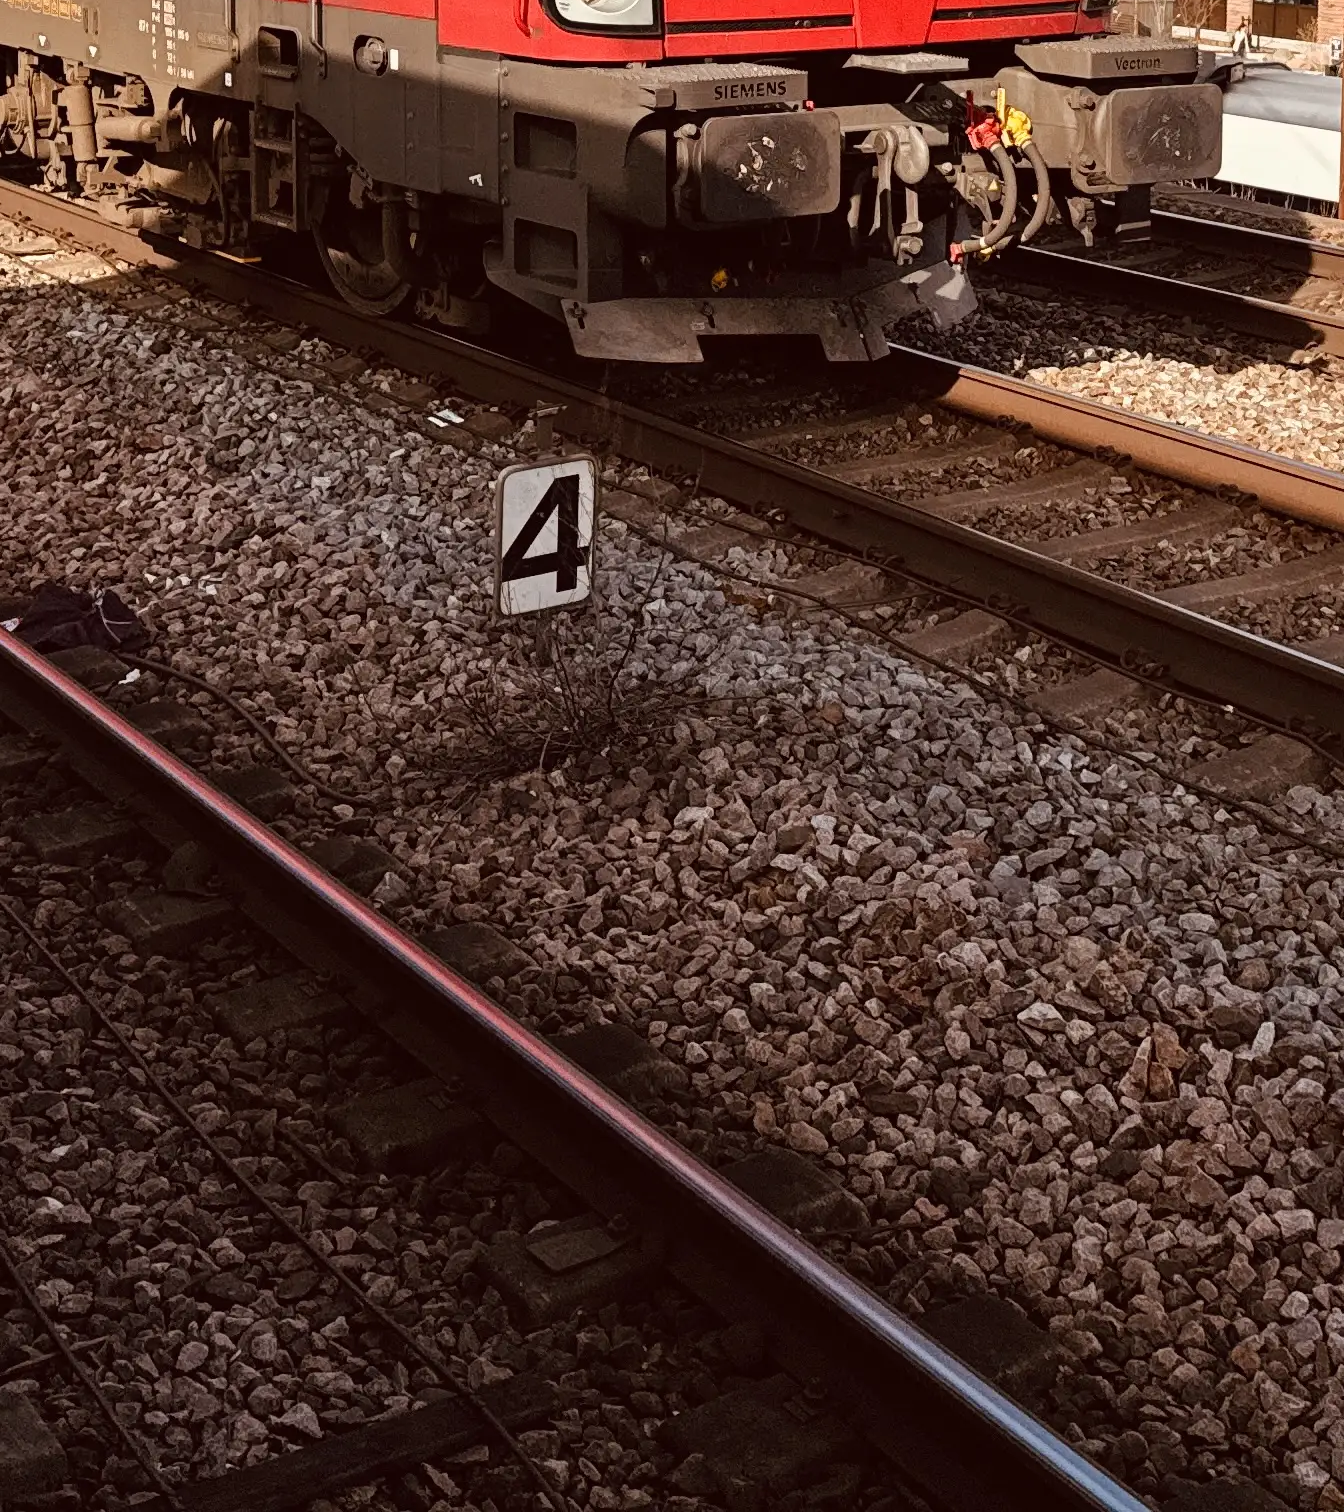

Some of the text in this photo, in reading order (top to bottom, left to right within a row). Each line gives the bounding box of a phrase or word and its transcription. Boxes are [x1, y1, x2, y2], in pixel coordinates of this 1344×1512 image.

[1115, 55, 1161, 71] Vectron
[714, 80, 787, 101] SIEMENS
[501, 473, 590, 593] 4
